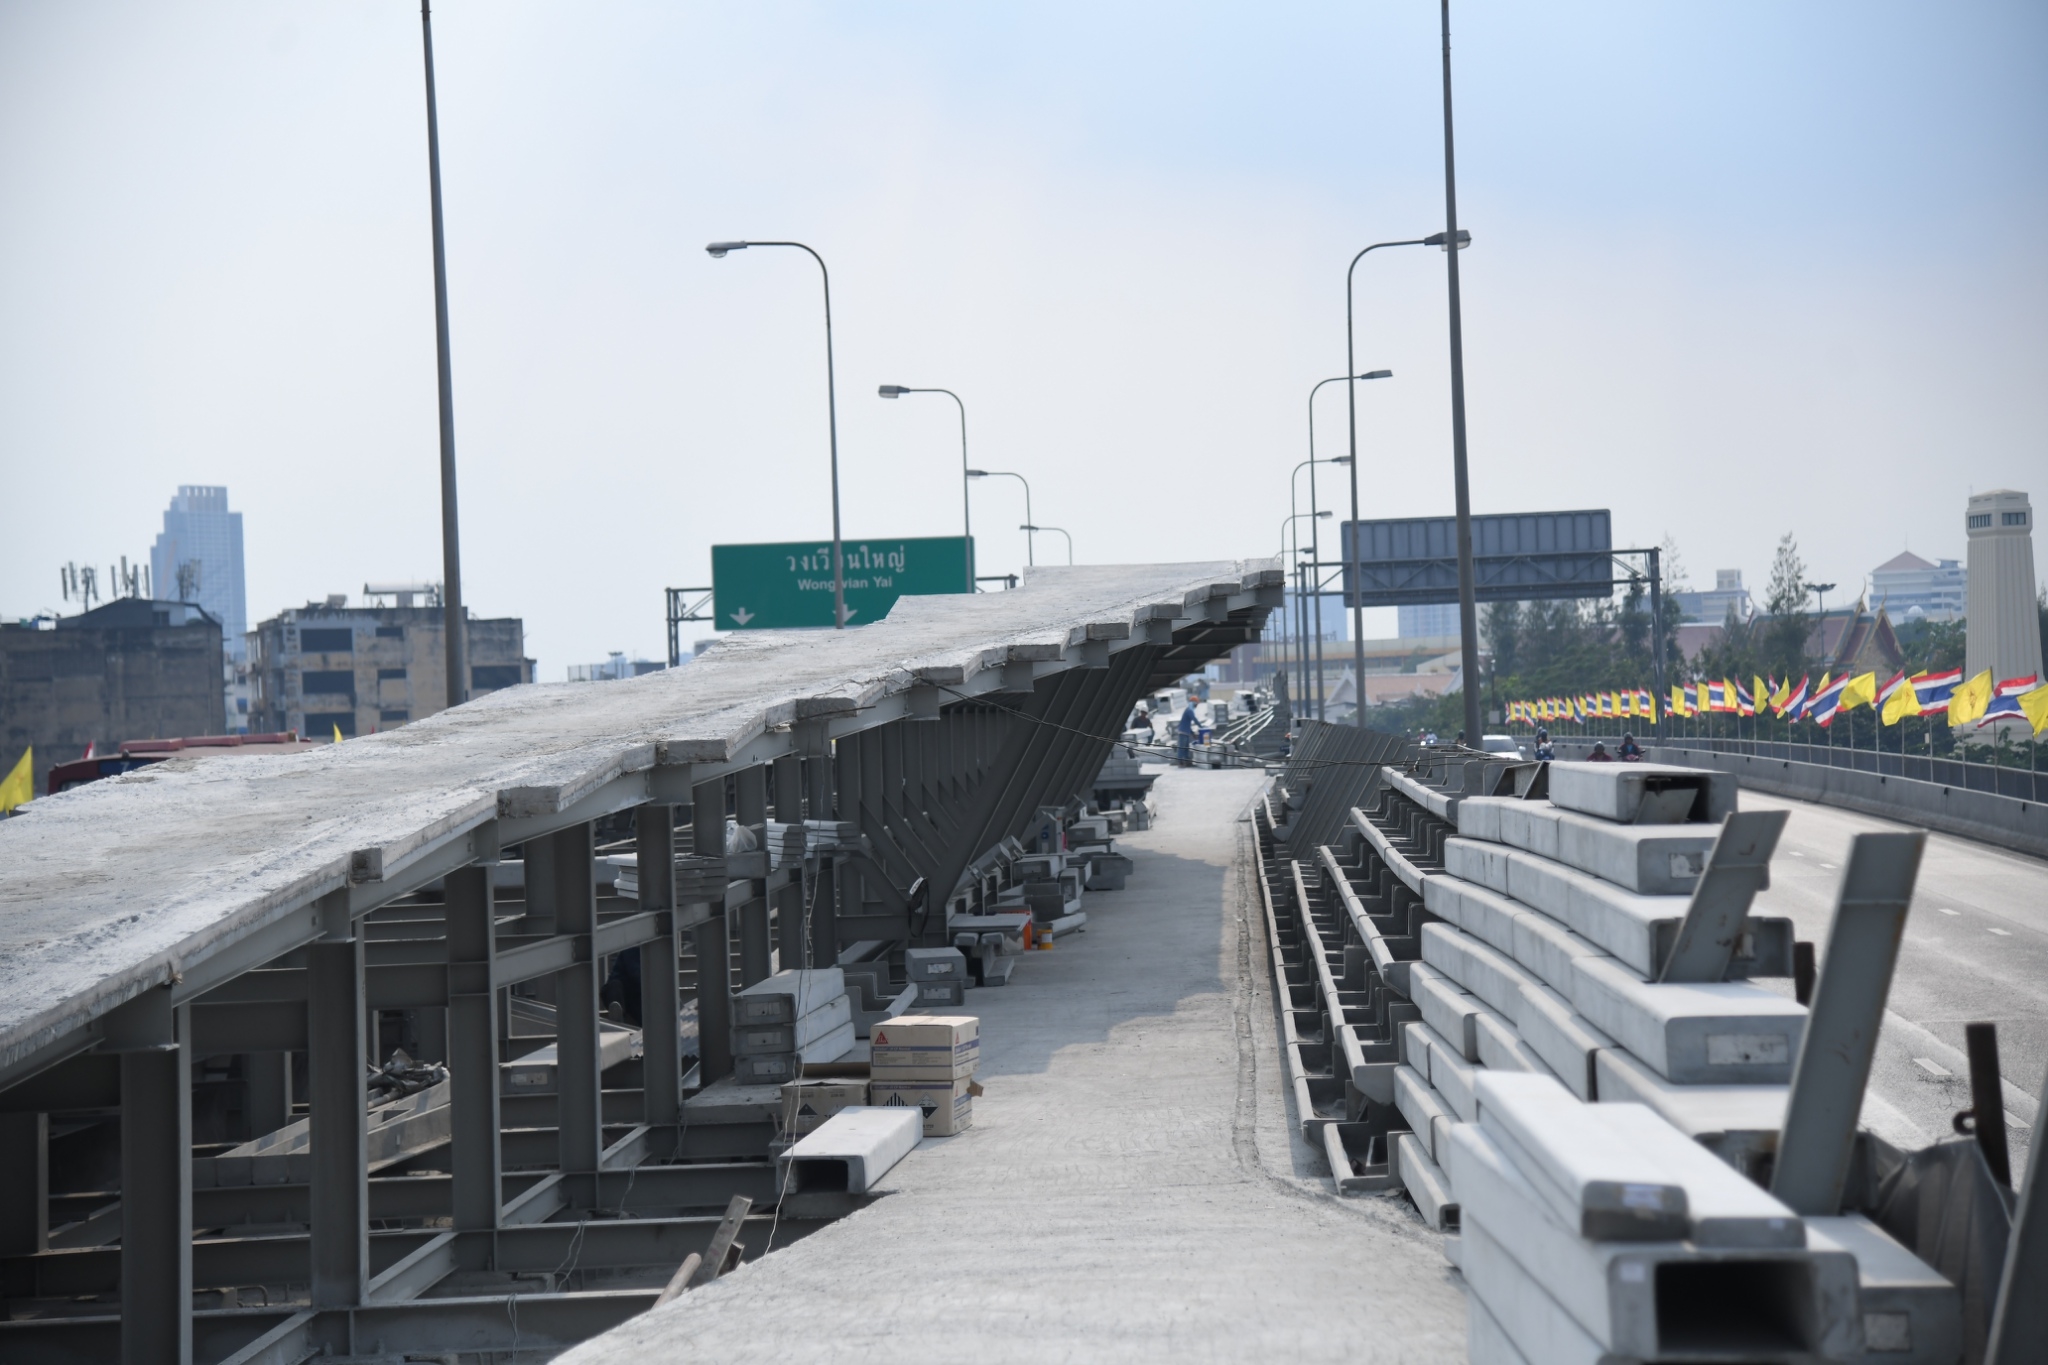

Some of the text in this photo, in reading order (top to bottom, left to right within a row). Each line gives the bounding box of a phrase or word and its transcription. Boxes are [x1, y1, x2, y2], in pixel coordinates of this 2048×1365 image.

[786, 545, 905, 573] วงเวีนใหญ่
[873, 575, 893, 588] Yai
